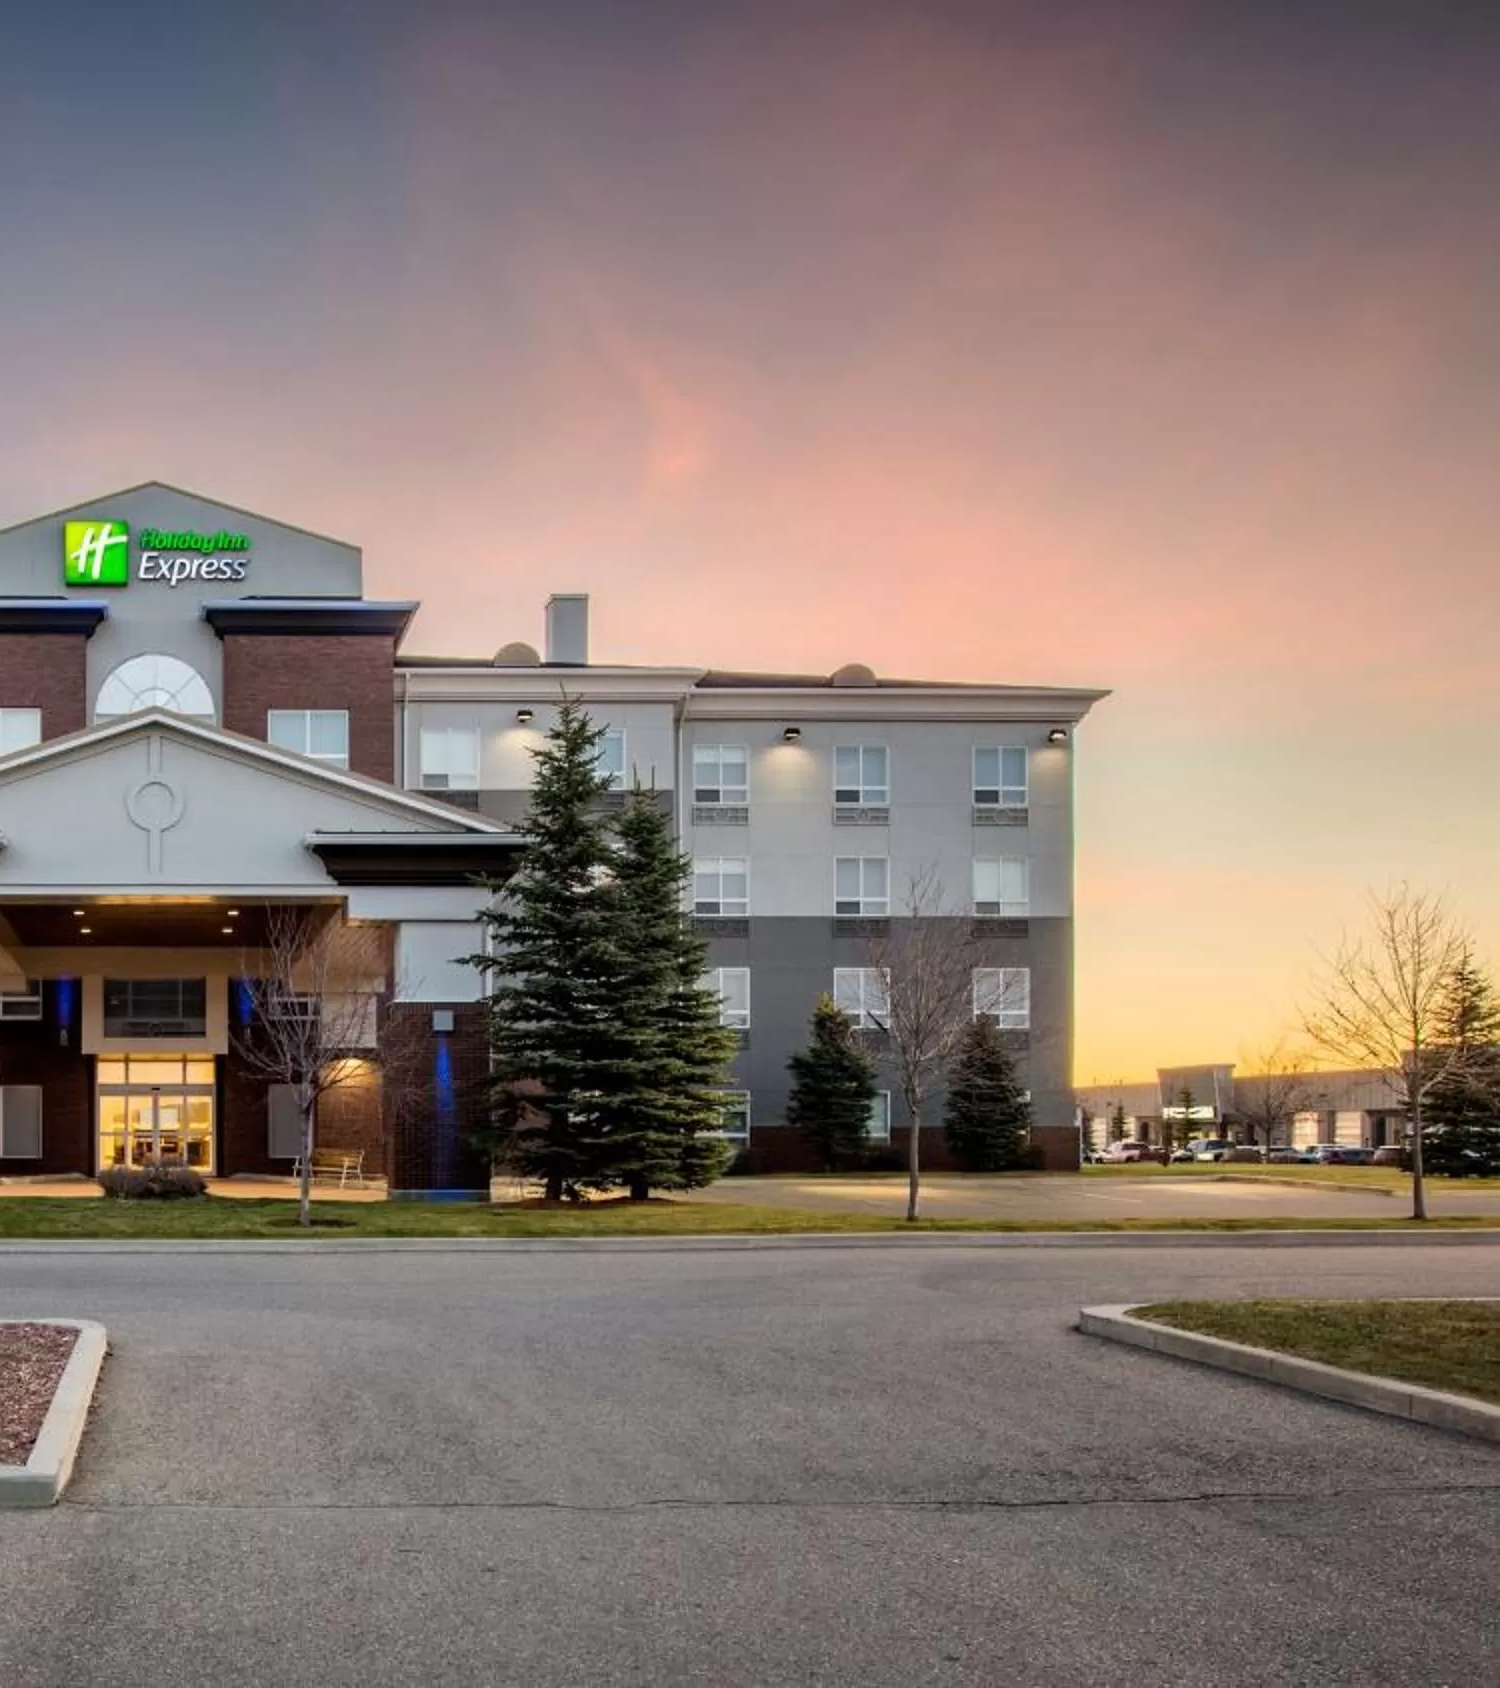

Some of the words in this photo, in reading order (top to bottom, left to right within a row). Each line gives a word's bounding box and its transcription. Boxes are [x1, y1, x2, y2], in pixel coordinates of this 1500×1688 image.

[140, 529, 216, 555] Holiday
[219, 530, 249, 551] Inn
[139, 552, 247, 587] Express
